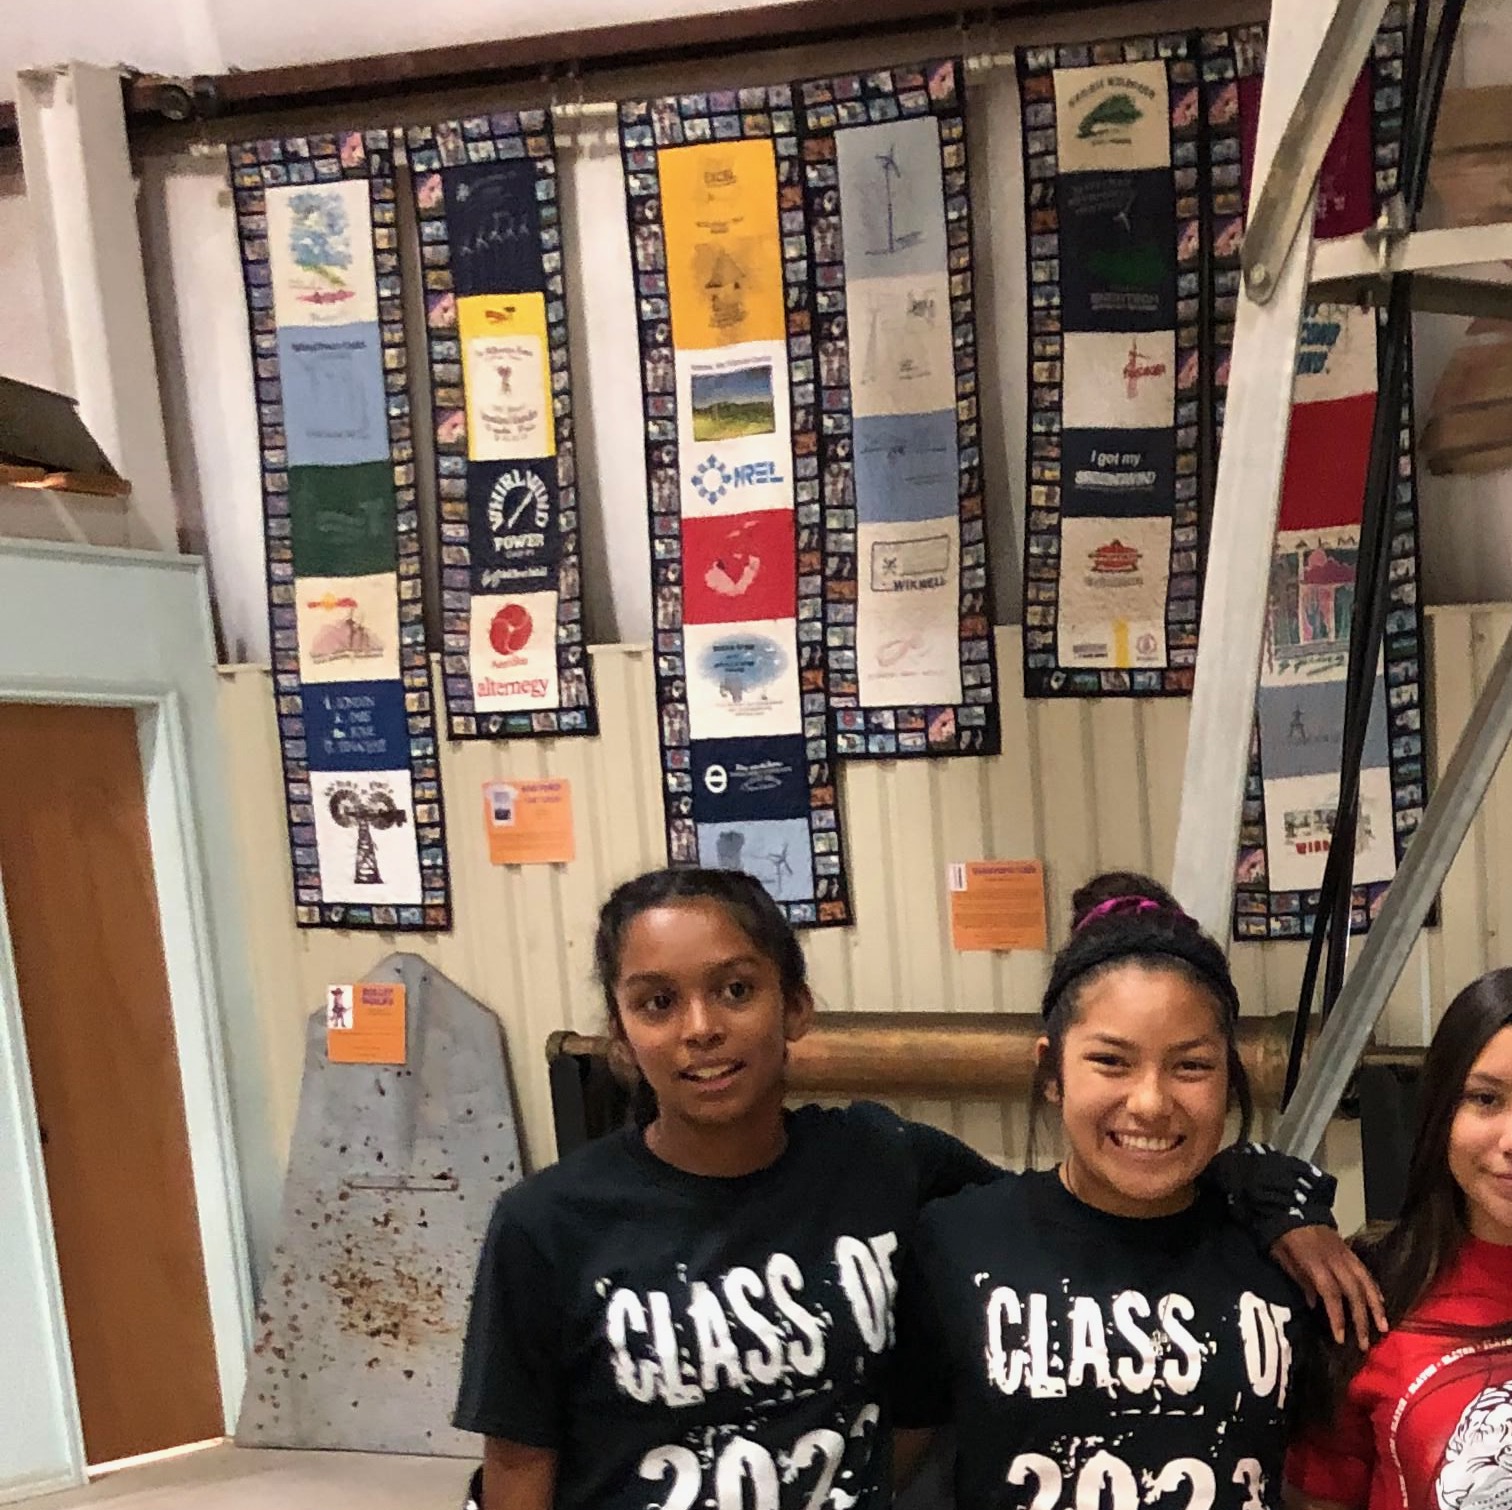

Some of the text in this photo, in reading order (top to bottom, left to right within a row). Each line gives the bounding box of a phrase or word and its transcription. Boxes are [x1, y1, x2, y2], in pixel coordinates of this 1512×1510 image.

[1091, 450, 1142, 468] I got my
[734, 461, 784, 488] NREL
[494, 533, 545, 551] POWER
[477, 676, 549, 698] alternegy
[605, 1252, 826, 1407] CLASS
[985, 1286, 1292, 1410] CLASS OF
